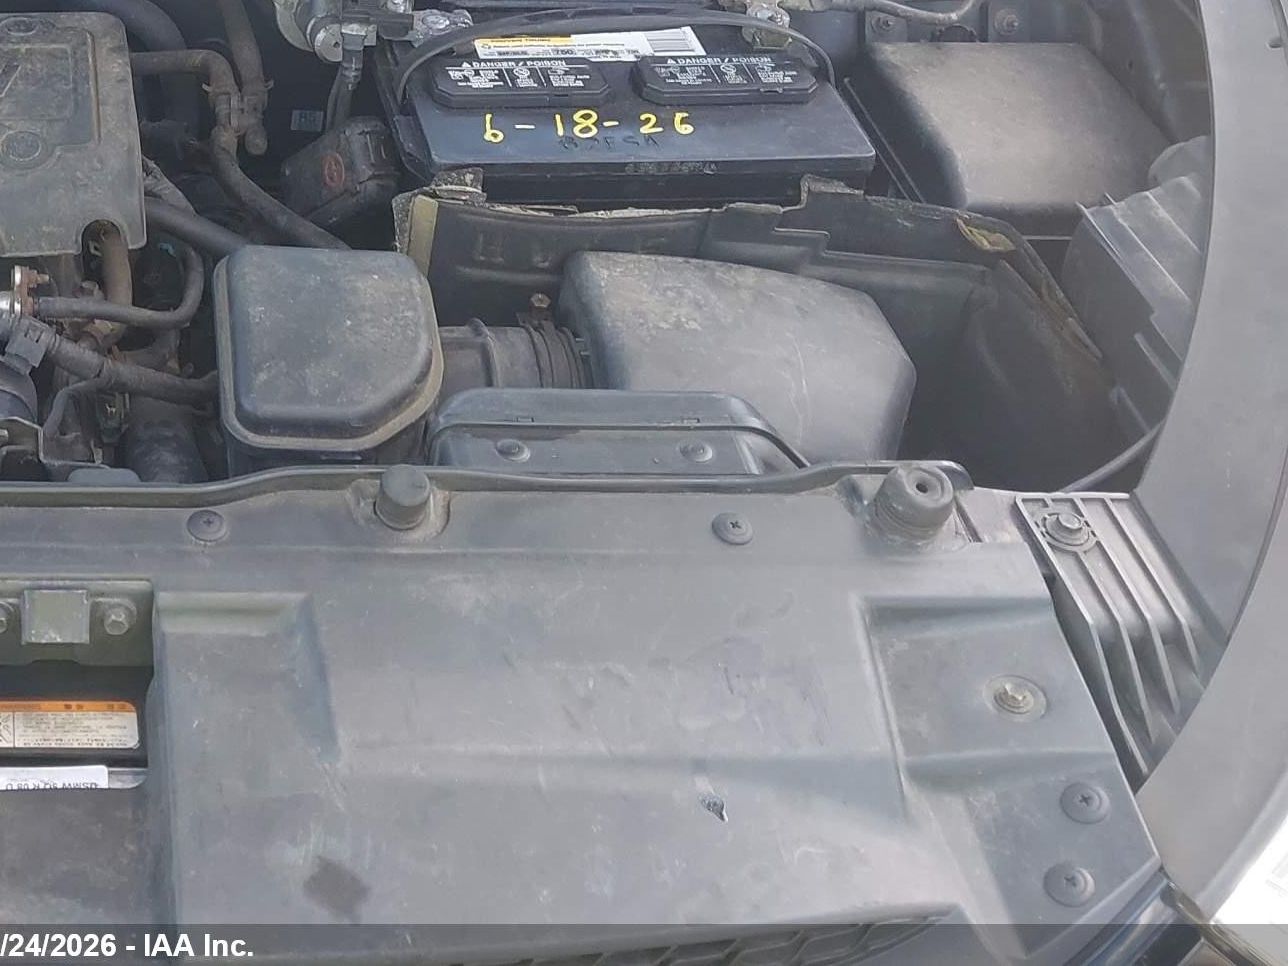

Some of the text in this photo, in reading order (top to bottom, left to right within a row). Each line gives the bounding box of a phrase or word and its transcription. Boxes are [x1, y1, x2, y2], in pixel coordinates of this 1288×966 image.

[472, 60, 516, 68] DANGER
[526, 59, 567, 67] POISON
[678, 56, 722, 65] DANGER
